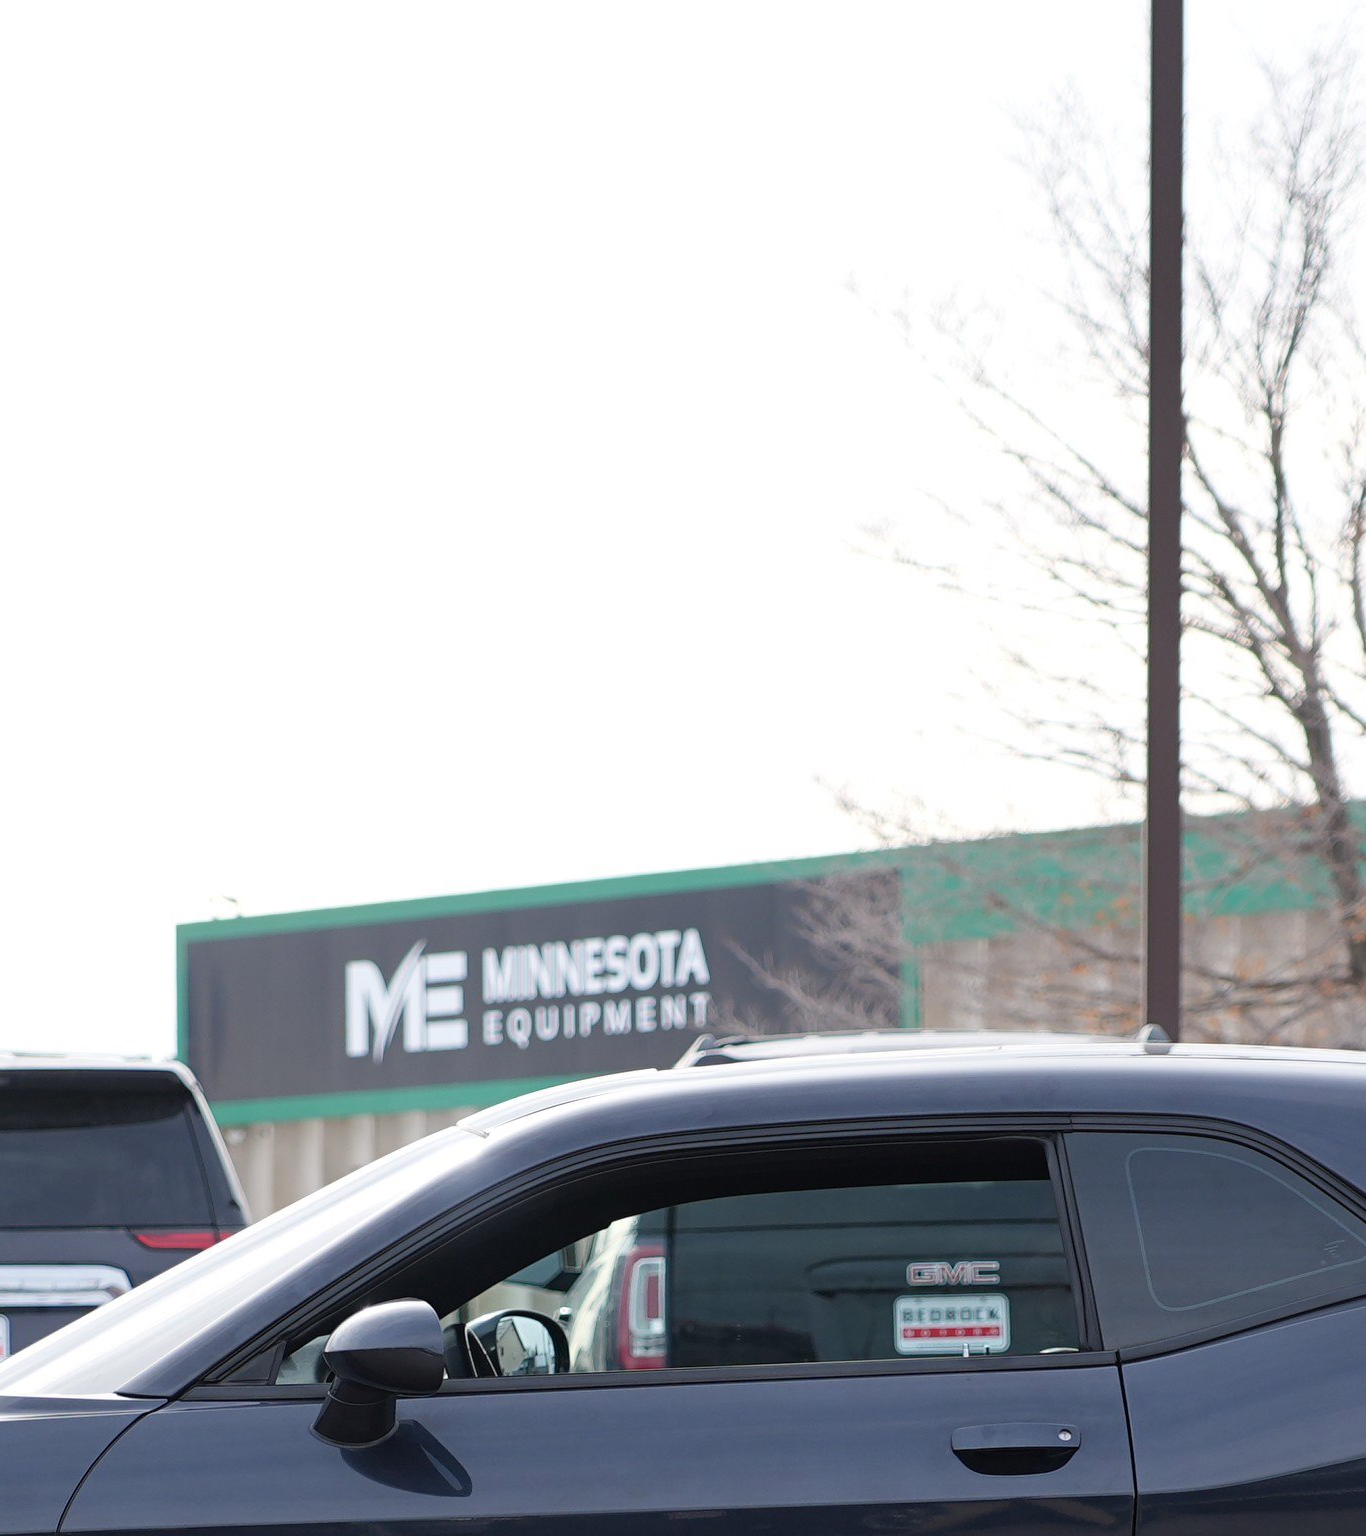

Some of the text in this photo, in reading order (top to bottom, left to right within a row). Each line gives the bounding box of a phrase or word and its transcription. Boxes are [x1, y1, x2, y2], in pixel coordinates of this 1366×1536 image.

[482, 927, 711, 1004] MINNESOTA
[345, 939, 469, 1066] ME
[482, 991, 712, 1049] EQUIPMENT
[906, 1261, 1000, 1286] GMC
[902, 1306, 1001, 1322] BEDROCK
